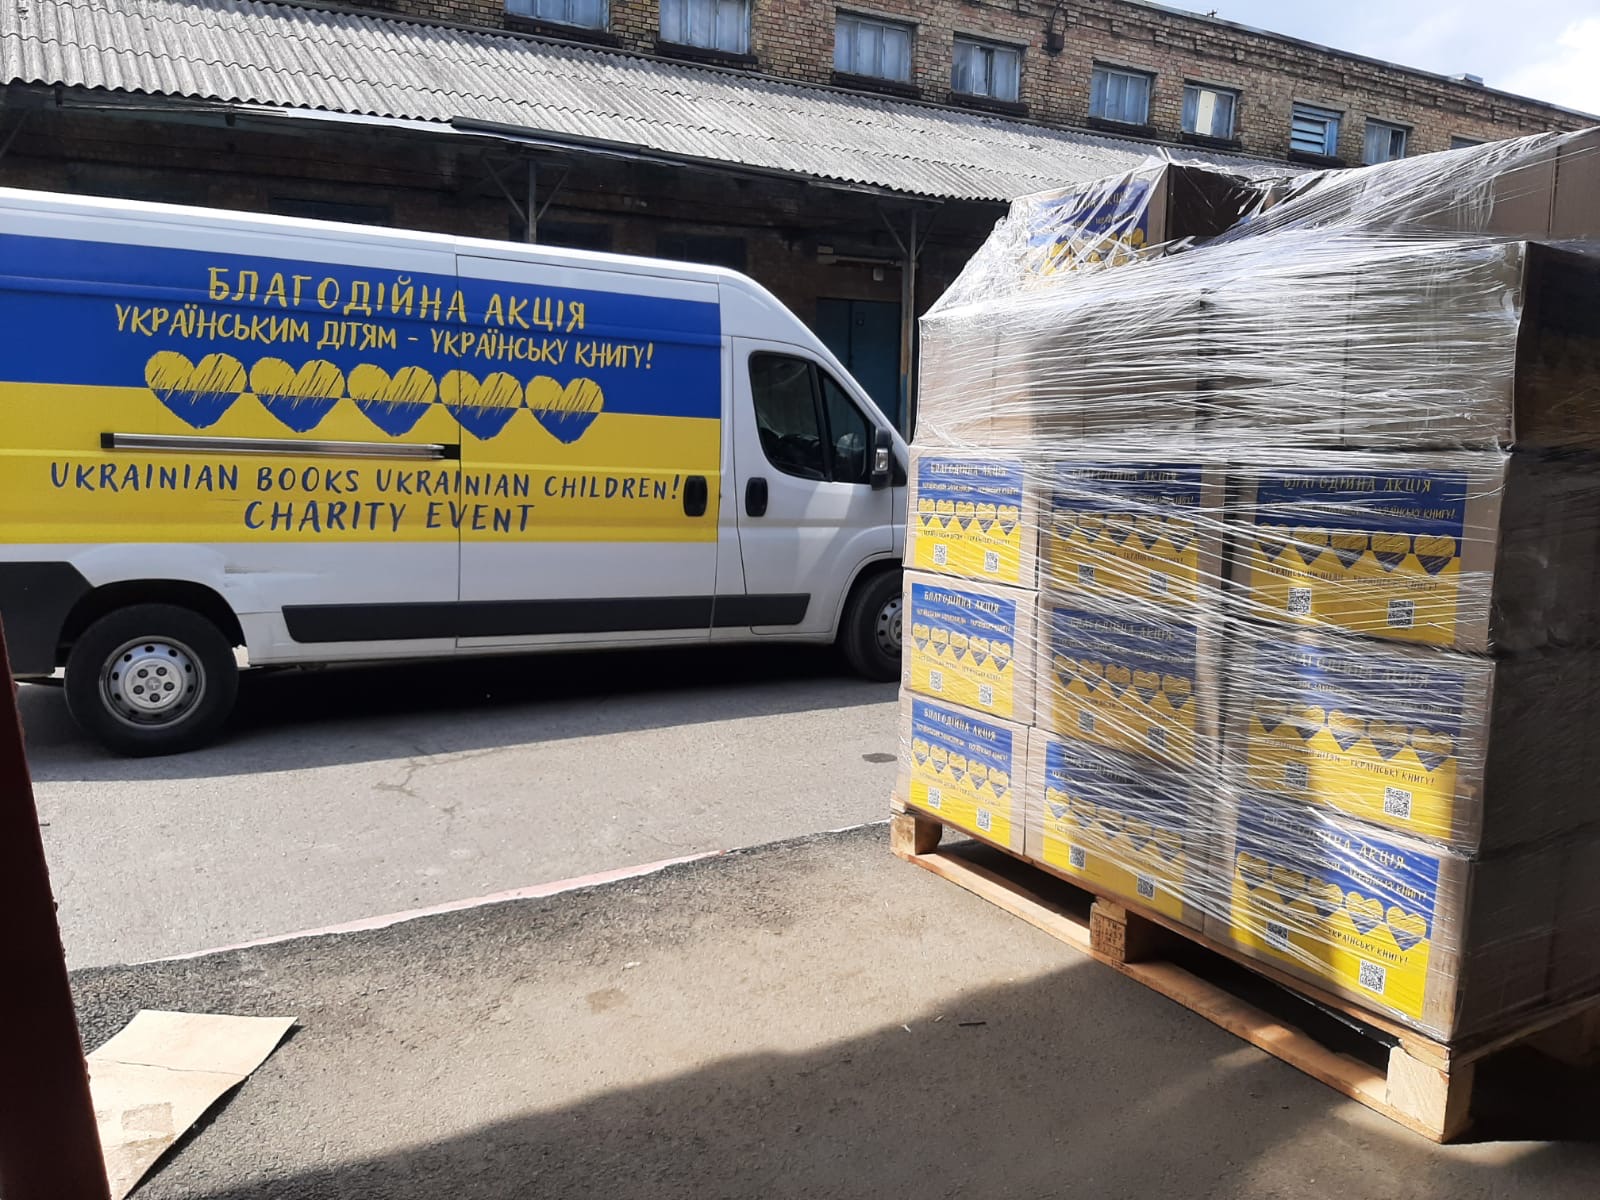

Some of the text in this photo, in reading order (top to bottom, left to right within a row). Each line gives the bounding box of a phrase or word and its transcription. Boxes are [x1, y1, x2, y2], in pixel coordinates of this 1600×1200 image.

[208, 267, 585, 332] БЛАГОДІЙНА АКЦІЯ
[115, 303, 309, 344] УКРАЇНСЬКИМ
[316, 320, 397, 350] ДІТЯМ
[431, 328, 569, 365] УКРАЇНСЬКУ
[575, 341, 655, 369] КНИГУ!
[51, 462, 680, 500] UKRAINIAN BOOKS UKRAINIAN CHILDREN!
[1384, 478, 1432, 493] АКЦІЯ
[244, 500, 535, 533] CHARITY EVENT
